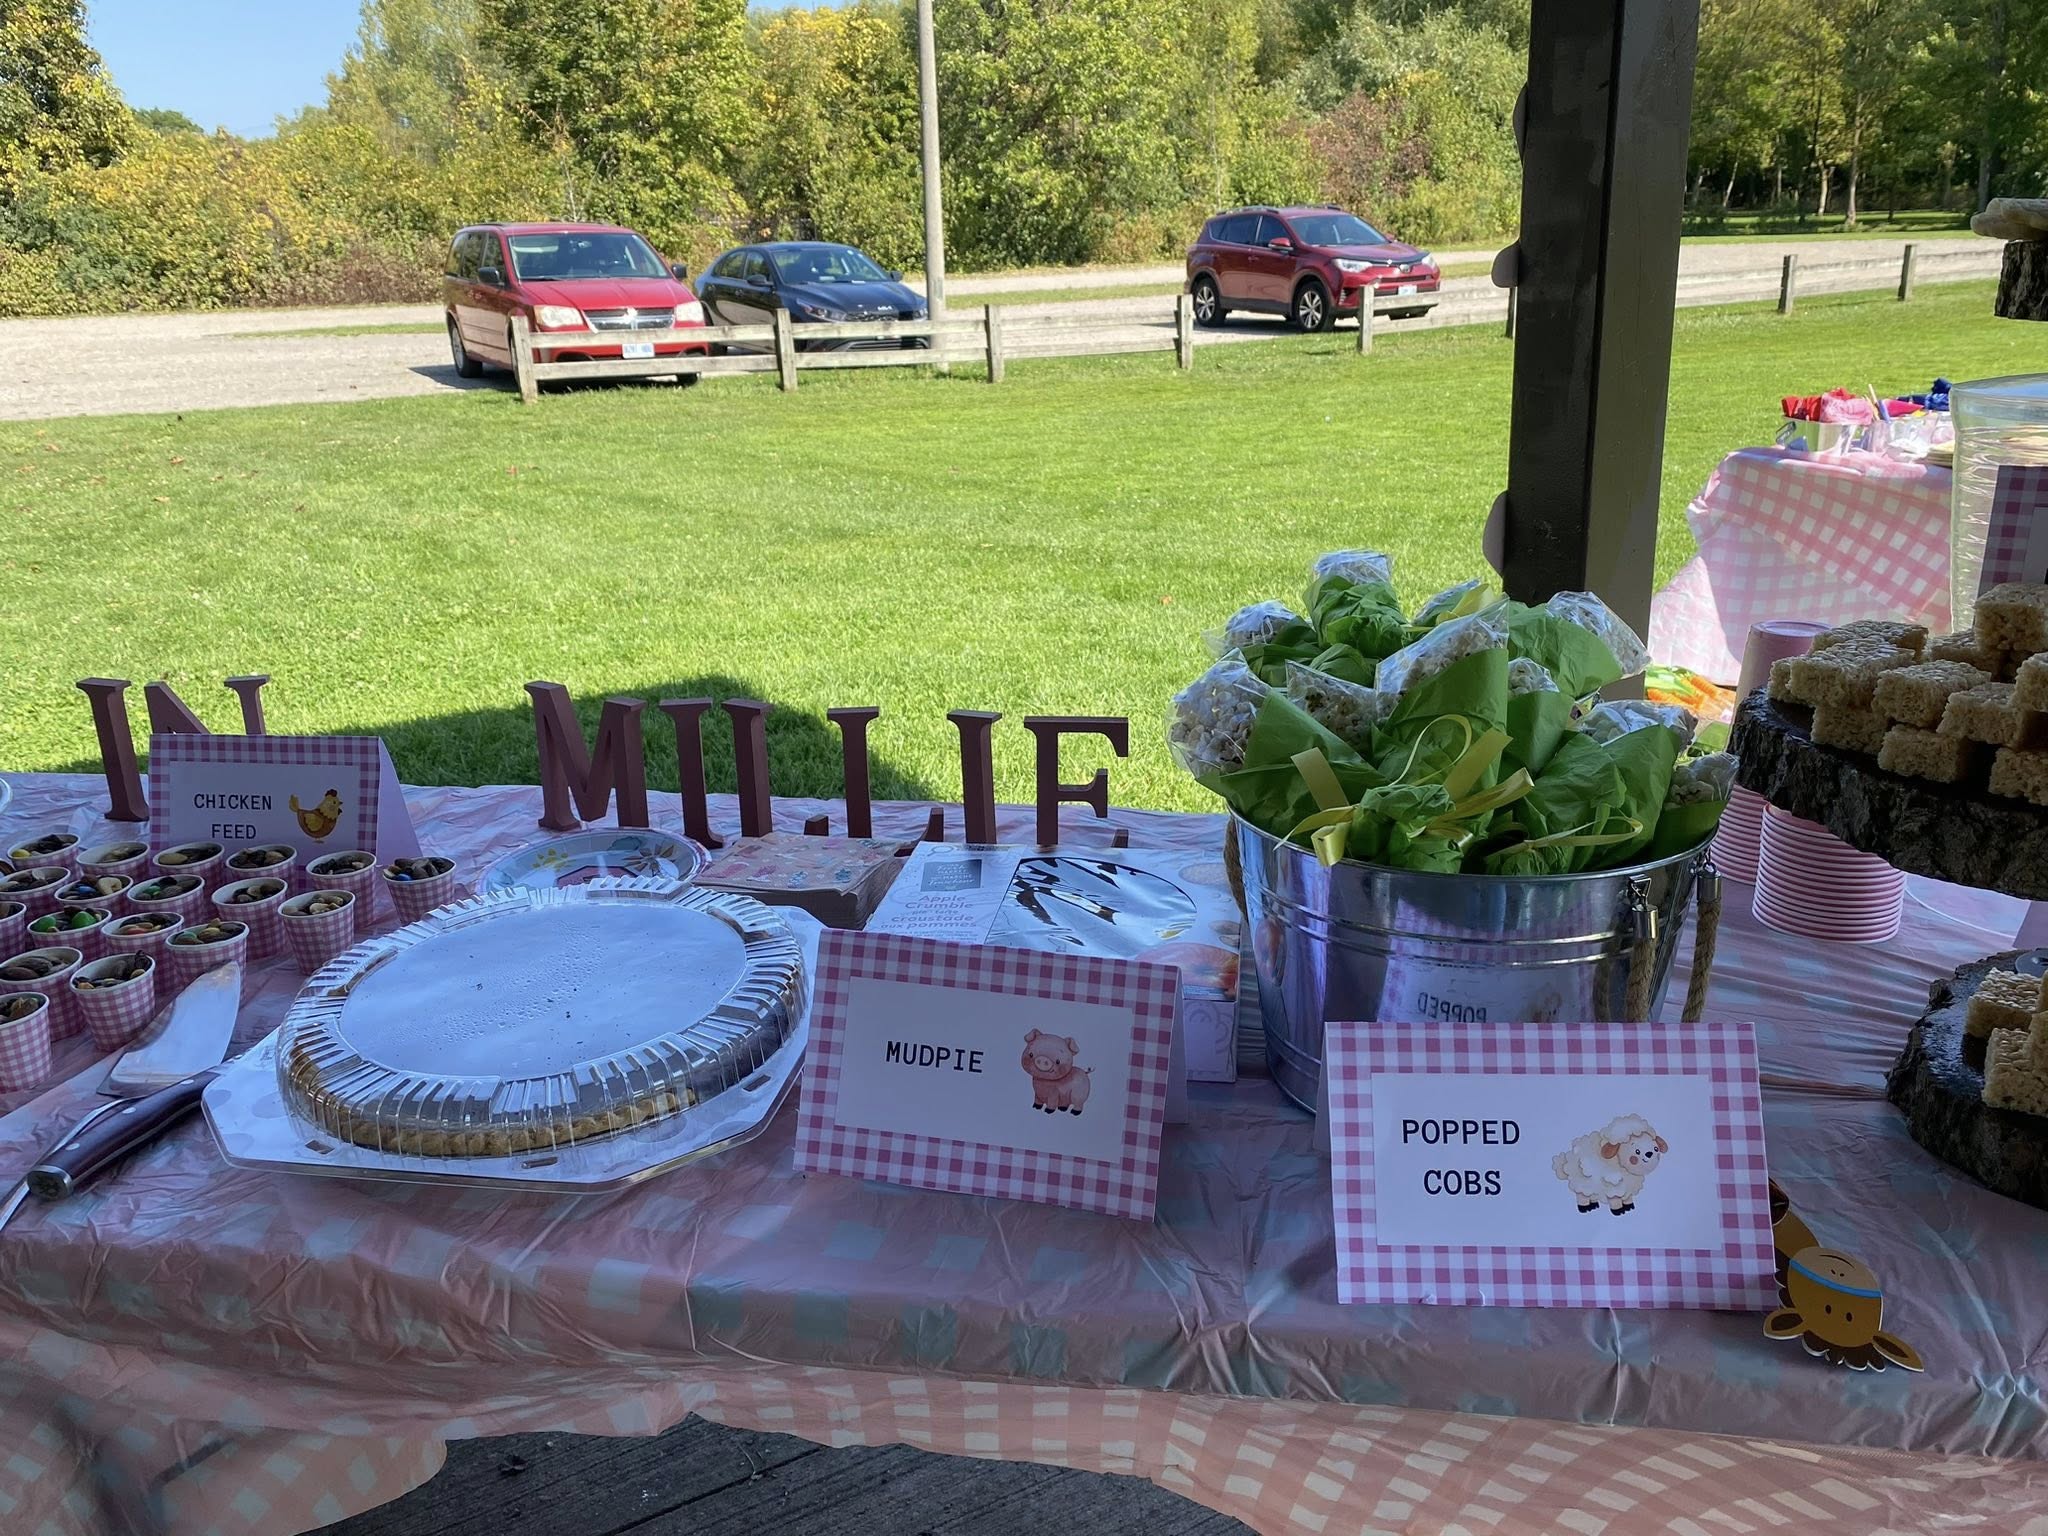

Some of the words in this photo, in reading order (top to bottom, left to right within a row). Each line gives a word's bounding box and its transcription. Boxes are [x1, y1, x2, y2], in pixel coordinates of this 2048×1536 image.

[524, 680, 1130, 857] MILLIE
[193, 793, 273, 812] CHICKEN
[211, 824, 257, 840] FEED
[905, 901, 974, 909] Crumble
[891, 914, 974, 922] croustade
[906, 921, 977, 929] pommes
[885, 1040, 984, 1073] MUDPIE
[1402, 1119, 1520, 1145] POPPED
[1423, 1169, 1502, 1196] COBS
